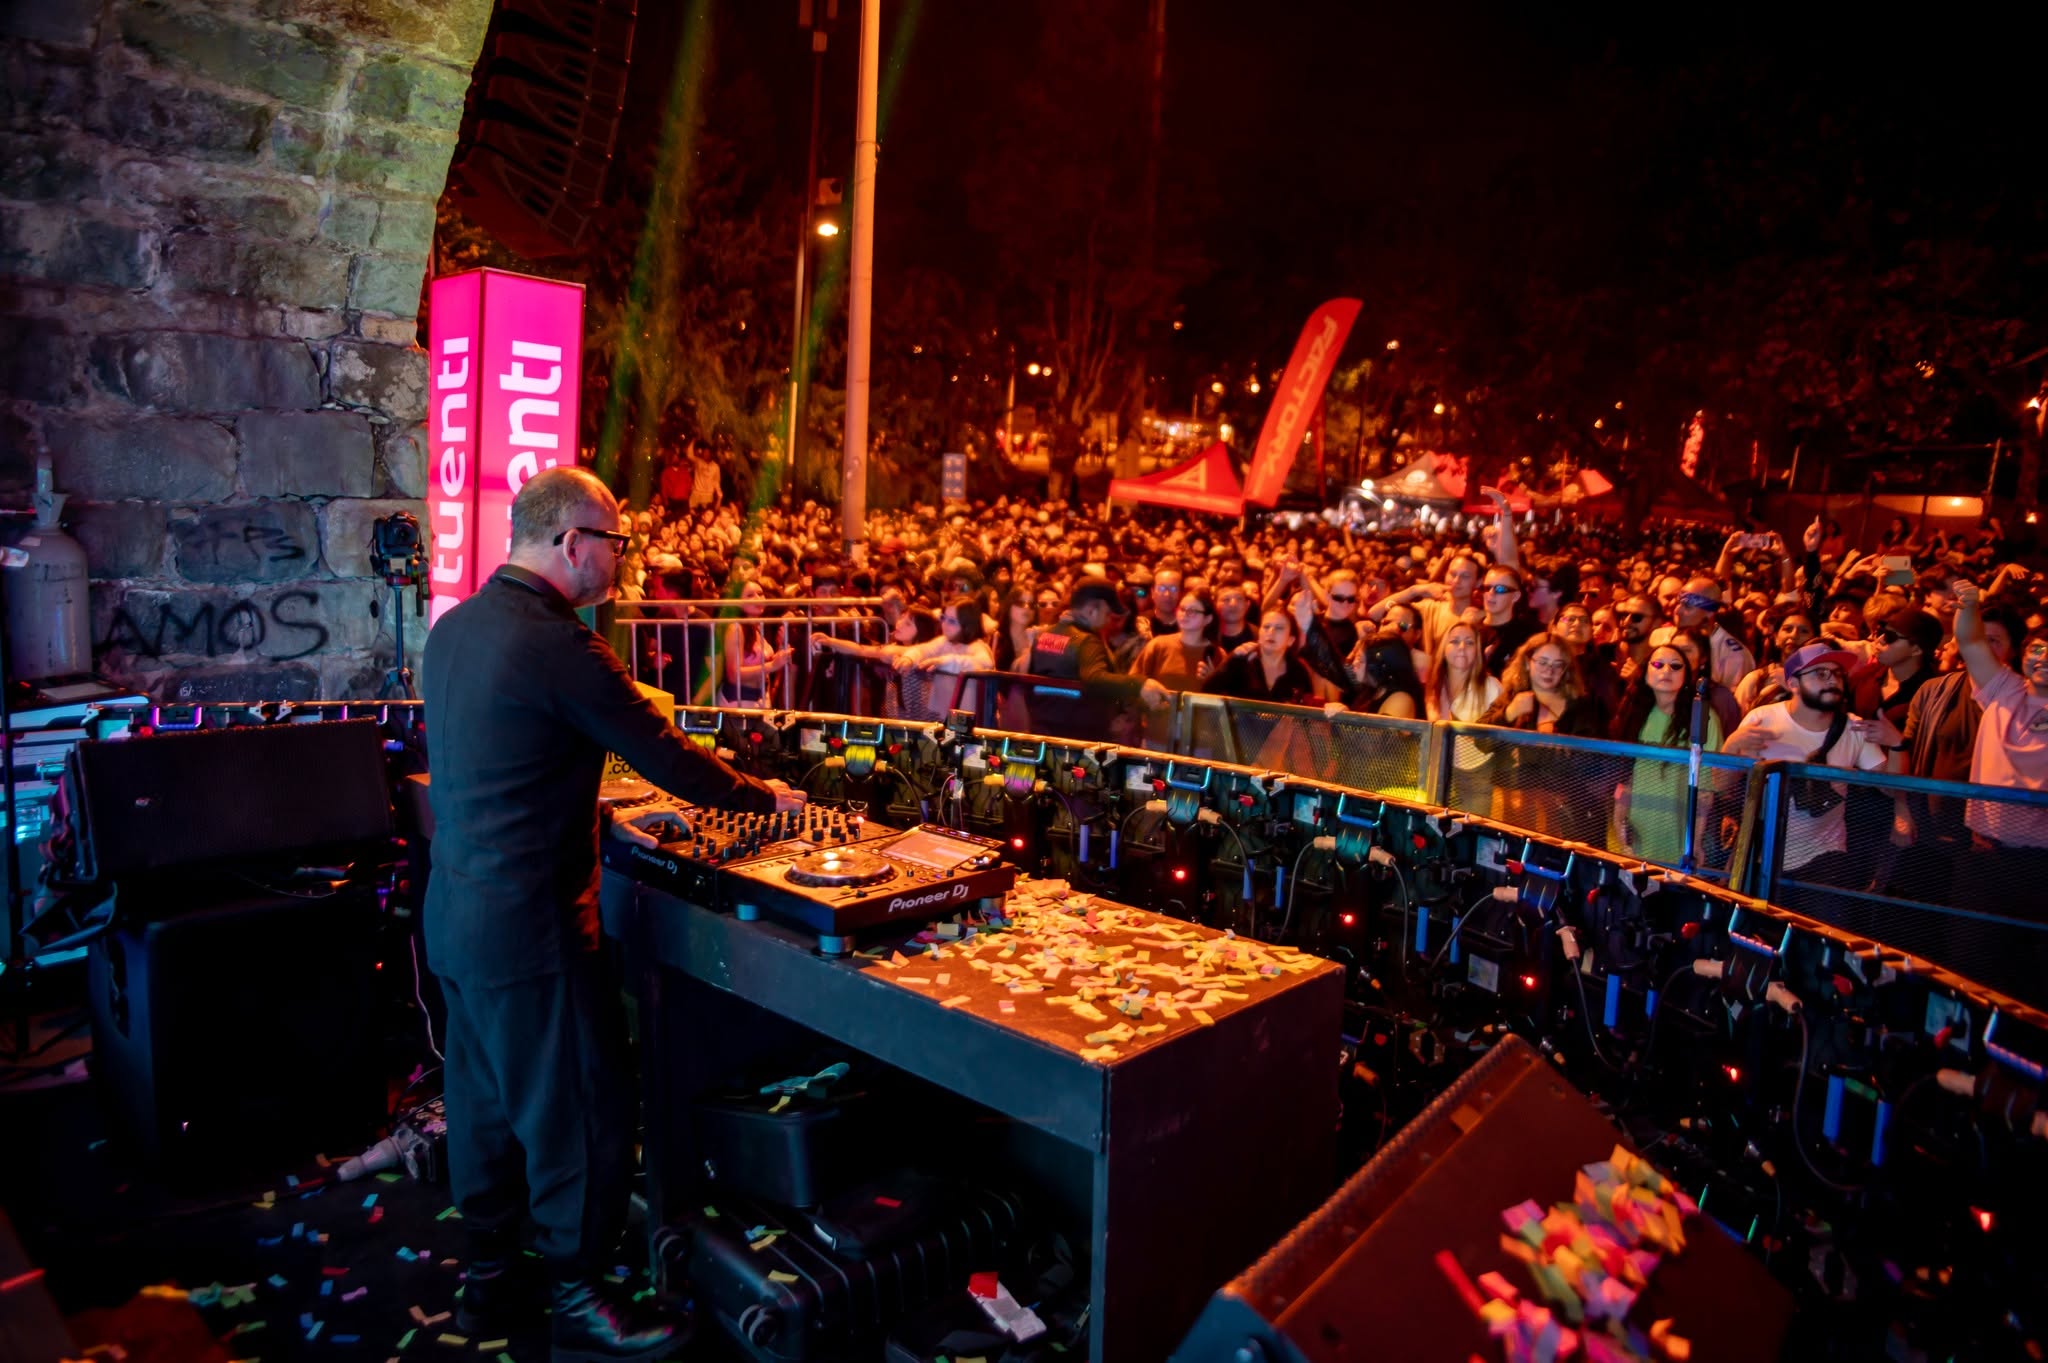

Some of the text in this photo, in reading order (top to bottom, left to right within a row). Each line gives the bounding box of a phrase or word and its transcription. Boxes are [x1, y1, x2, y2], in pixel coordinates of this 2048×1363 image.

[432, 336, 470, 584] tuenti
[93, 590, 330, 662] AMOS
[888, 890, 950, 913] Pioneer
